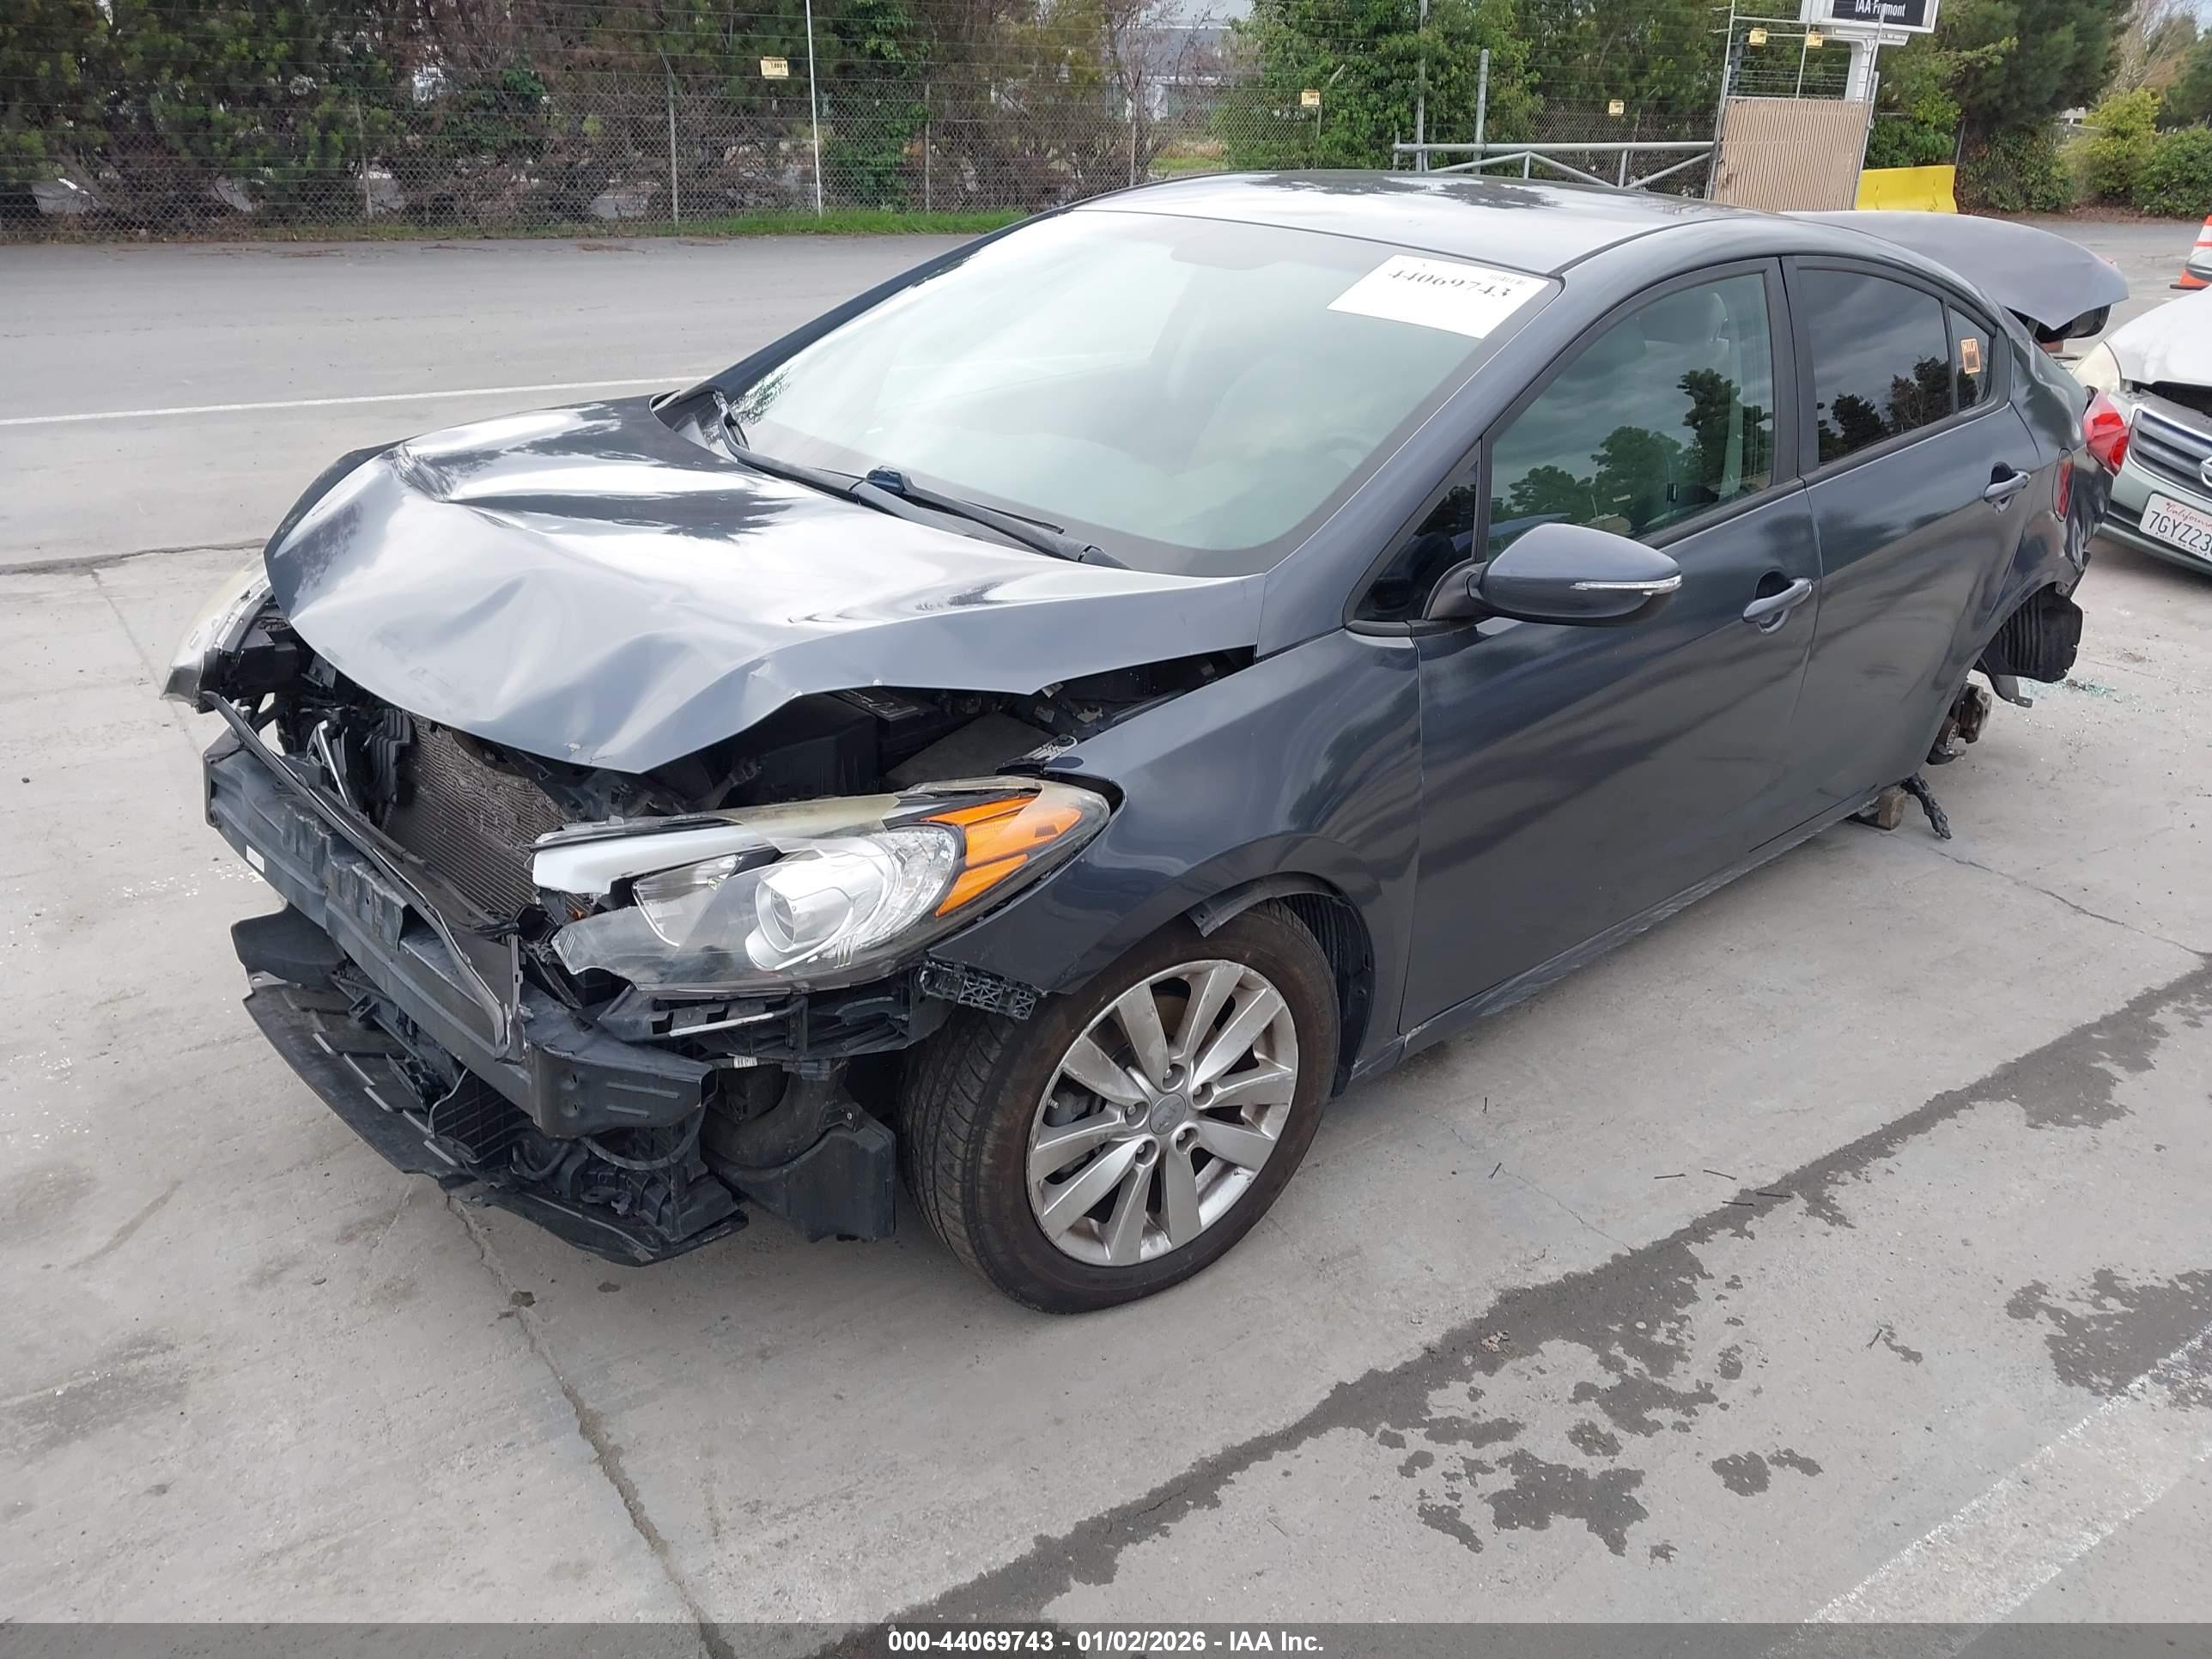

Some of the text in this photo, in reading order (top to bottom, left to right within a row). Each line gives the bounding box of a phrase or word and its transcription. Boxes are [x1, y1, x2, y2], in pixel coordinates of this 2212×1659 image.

[1855, 0, 1906, 17] IAA Frmont
[1388, 270, 1512, 297] 44069743
[2148, 510, 2212, 556] 7GYZ23
